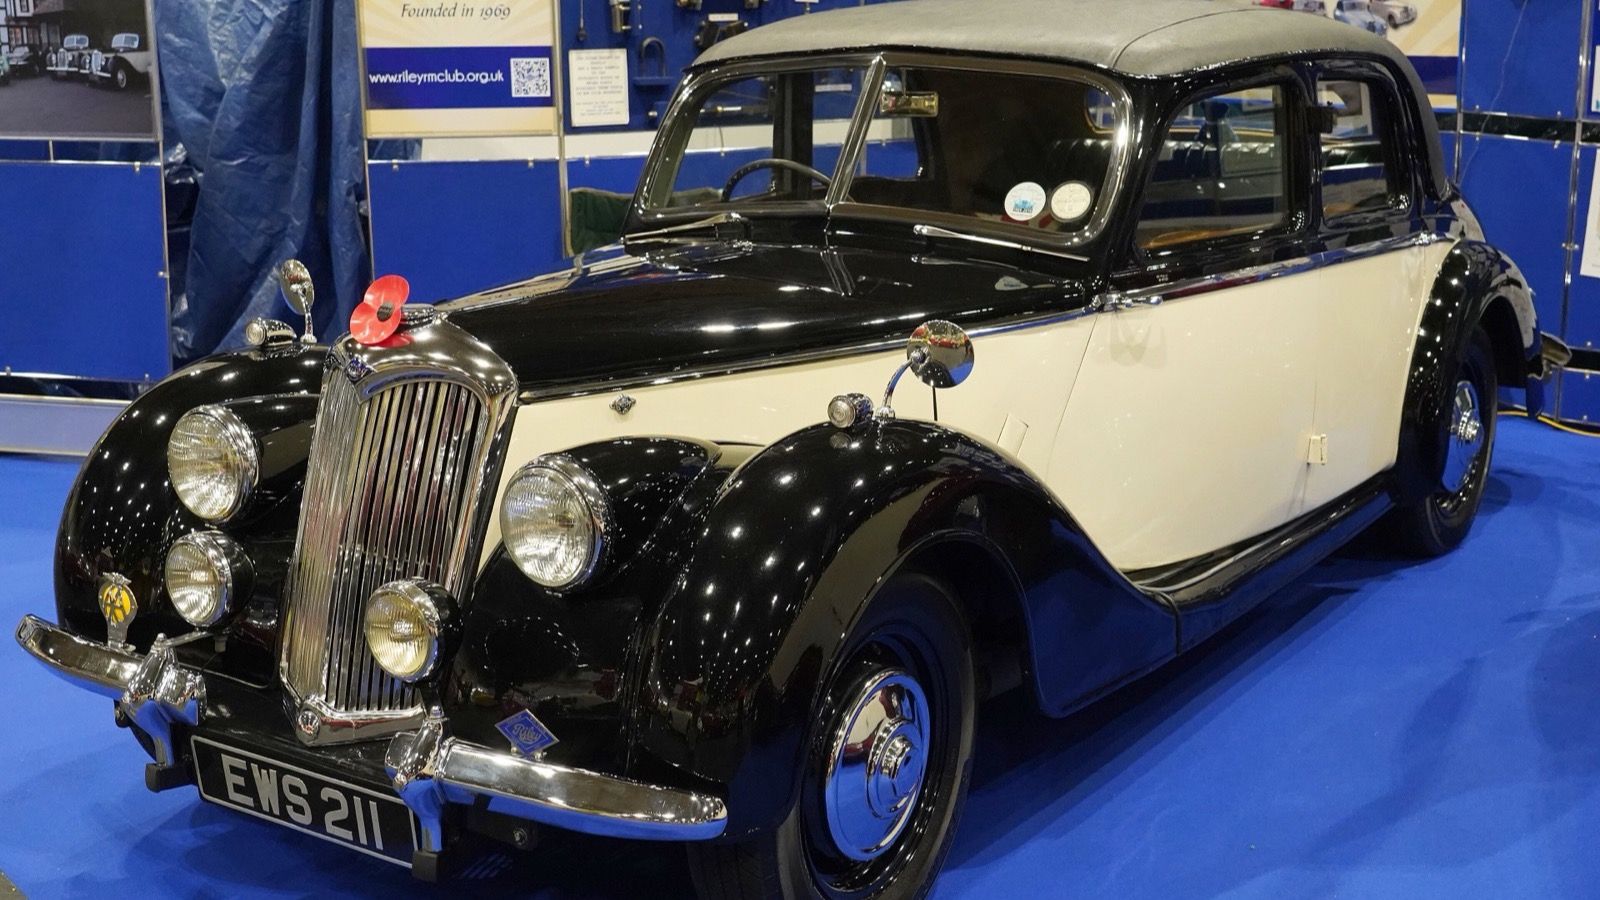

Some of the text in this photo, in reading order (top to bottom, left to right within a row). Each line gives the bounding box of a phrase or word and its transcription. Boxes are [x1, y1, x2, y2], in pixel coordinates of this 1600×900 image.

[401, 2, 511, 20] Founded in 1969
[368, 68, 504, 86] www.rileyrmclub.org.uk
[221, 753, 384, 851] EWS 211
